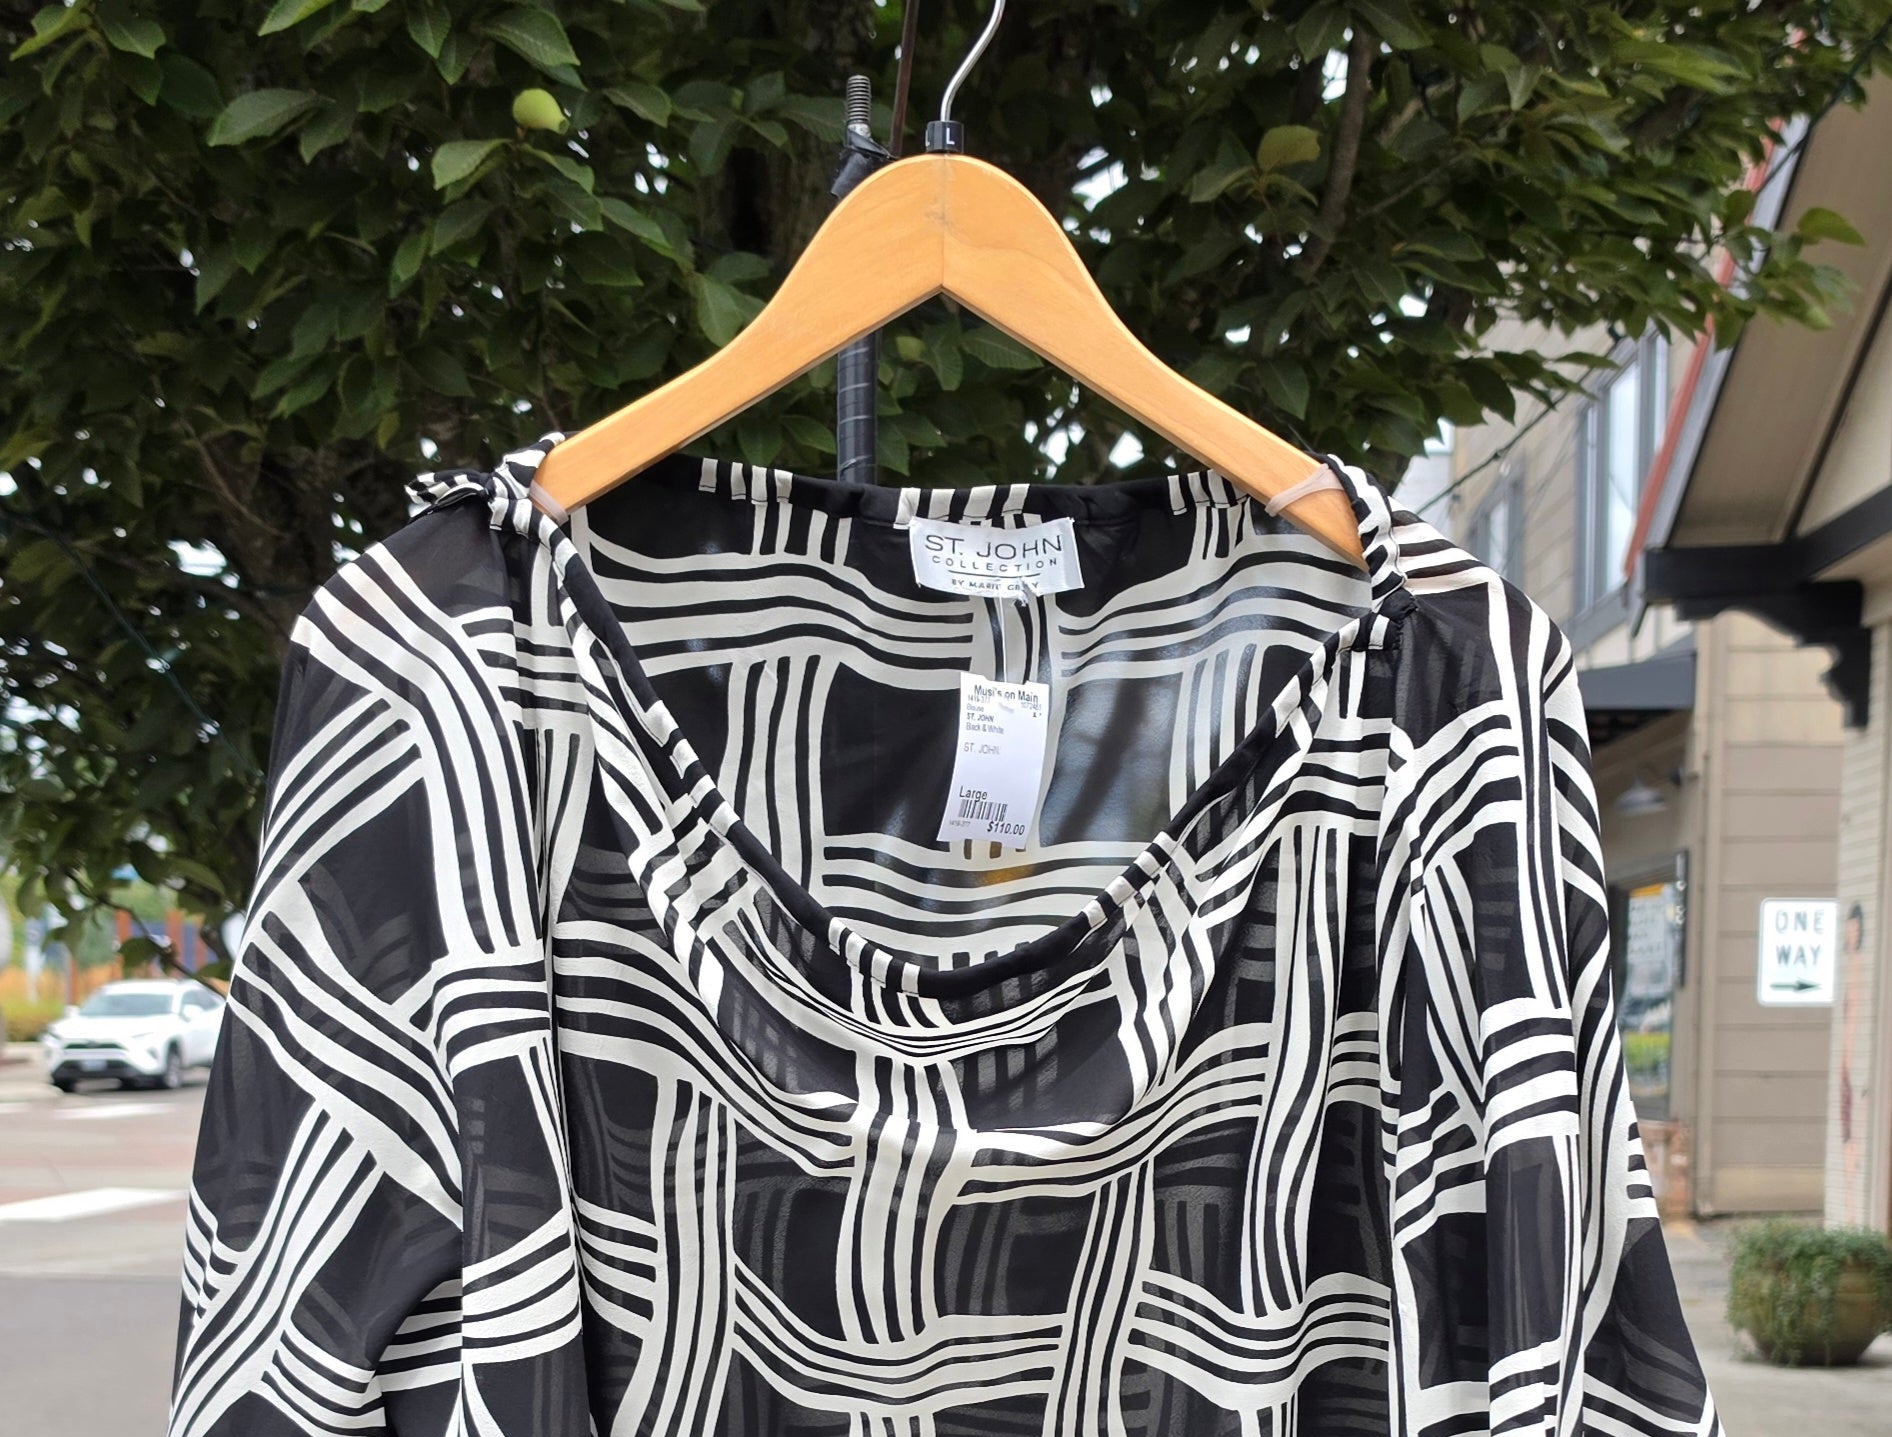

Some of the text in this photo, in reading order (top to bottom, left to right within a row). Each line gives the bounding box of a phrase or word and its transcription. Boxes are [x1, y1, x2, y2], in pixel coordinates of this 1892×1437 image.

[946, 127, 955, 145] L
[925, 534, 1062, 560] ST. JOHN
[932, 555, 1058, 572] COLLECTION
[1007, 582, 1039, 590] GRY
[1004, 690, 1016, 700] on
[1018, 689, 1038, 703] Main
[977, 714, 994, 722] JOHN
[959, 786, 988, 802] Large
[987, 821, 1025, 835] $110.00
[1775, 910, 1824, 934] ONE
[1775, 944, 1821, 967] WAY
